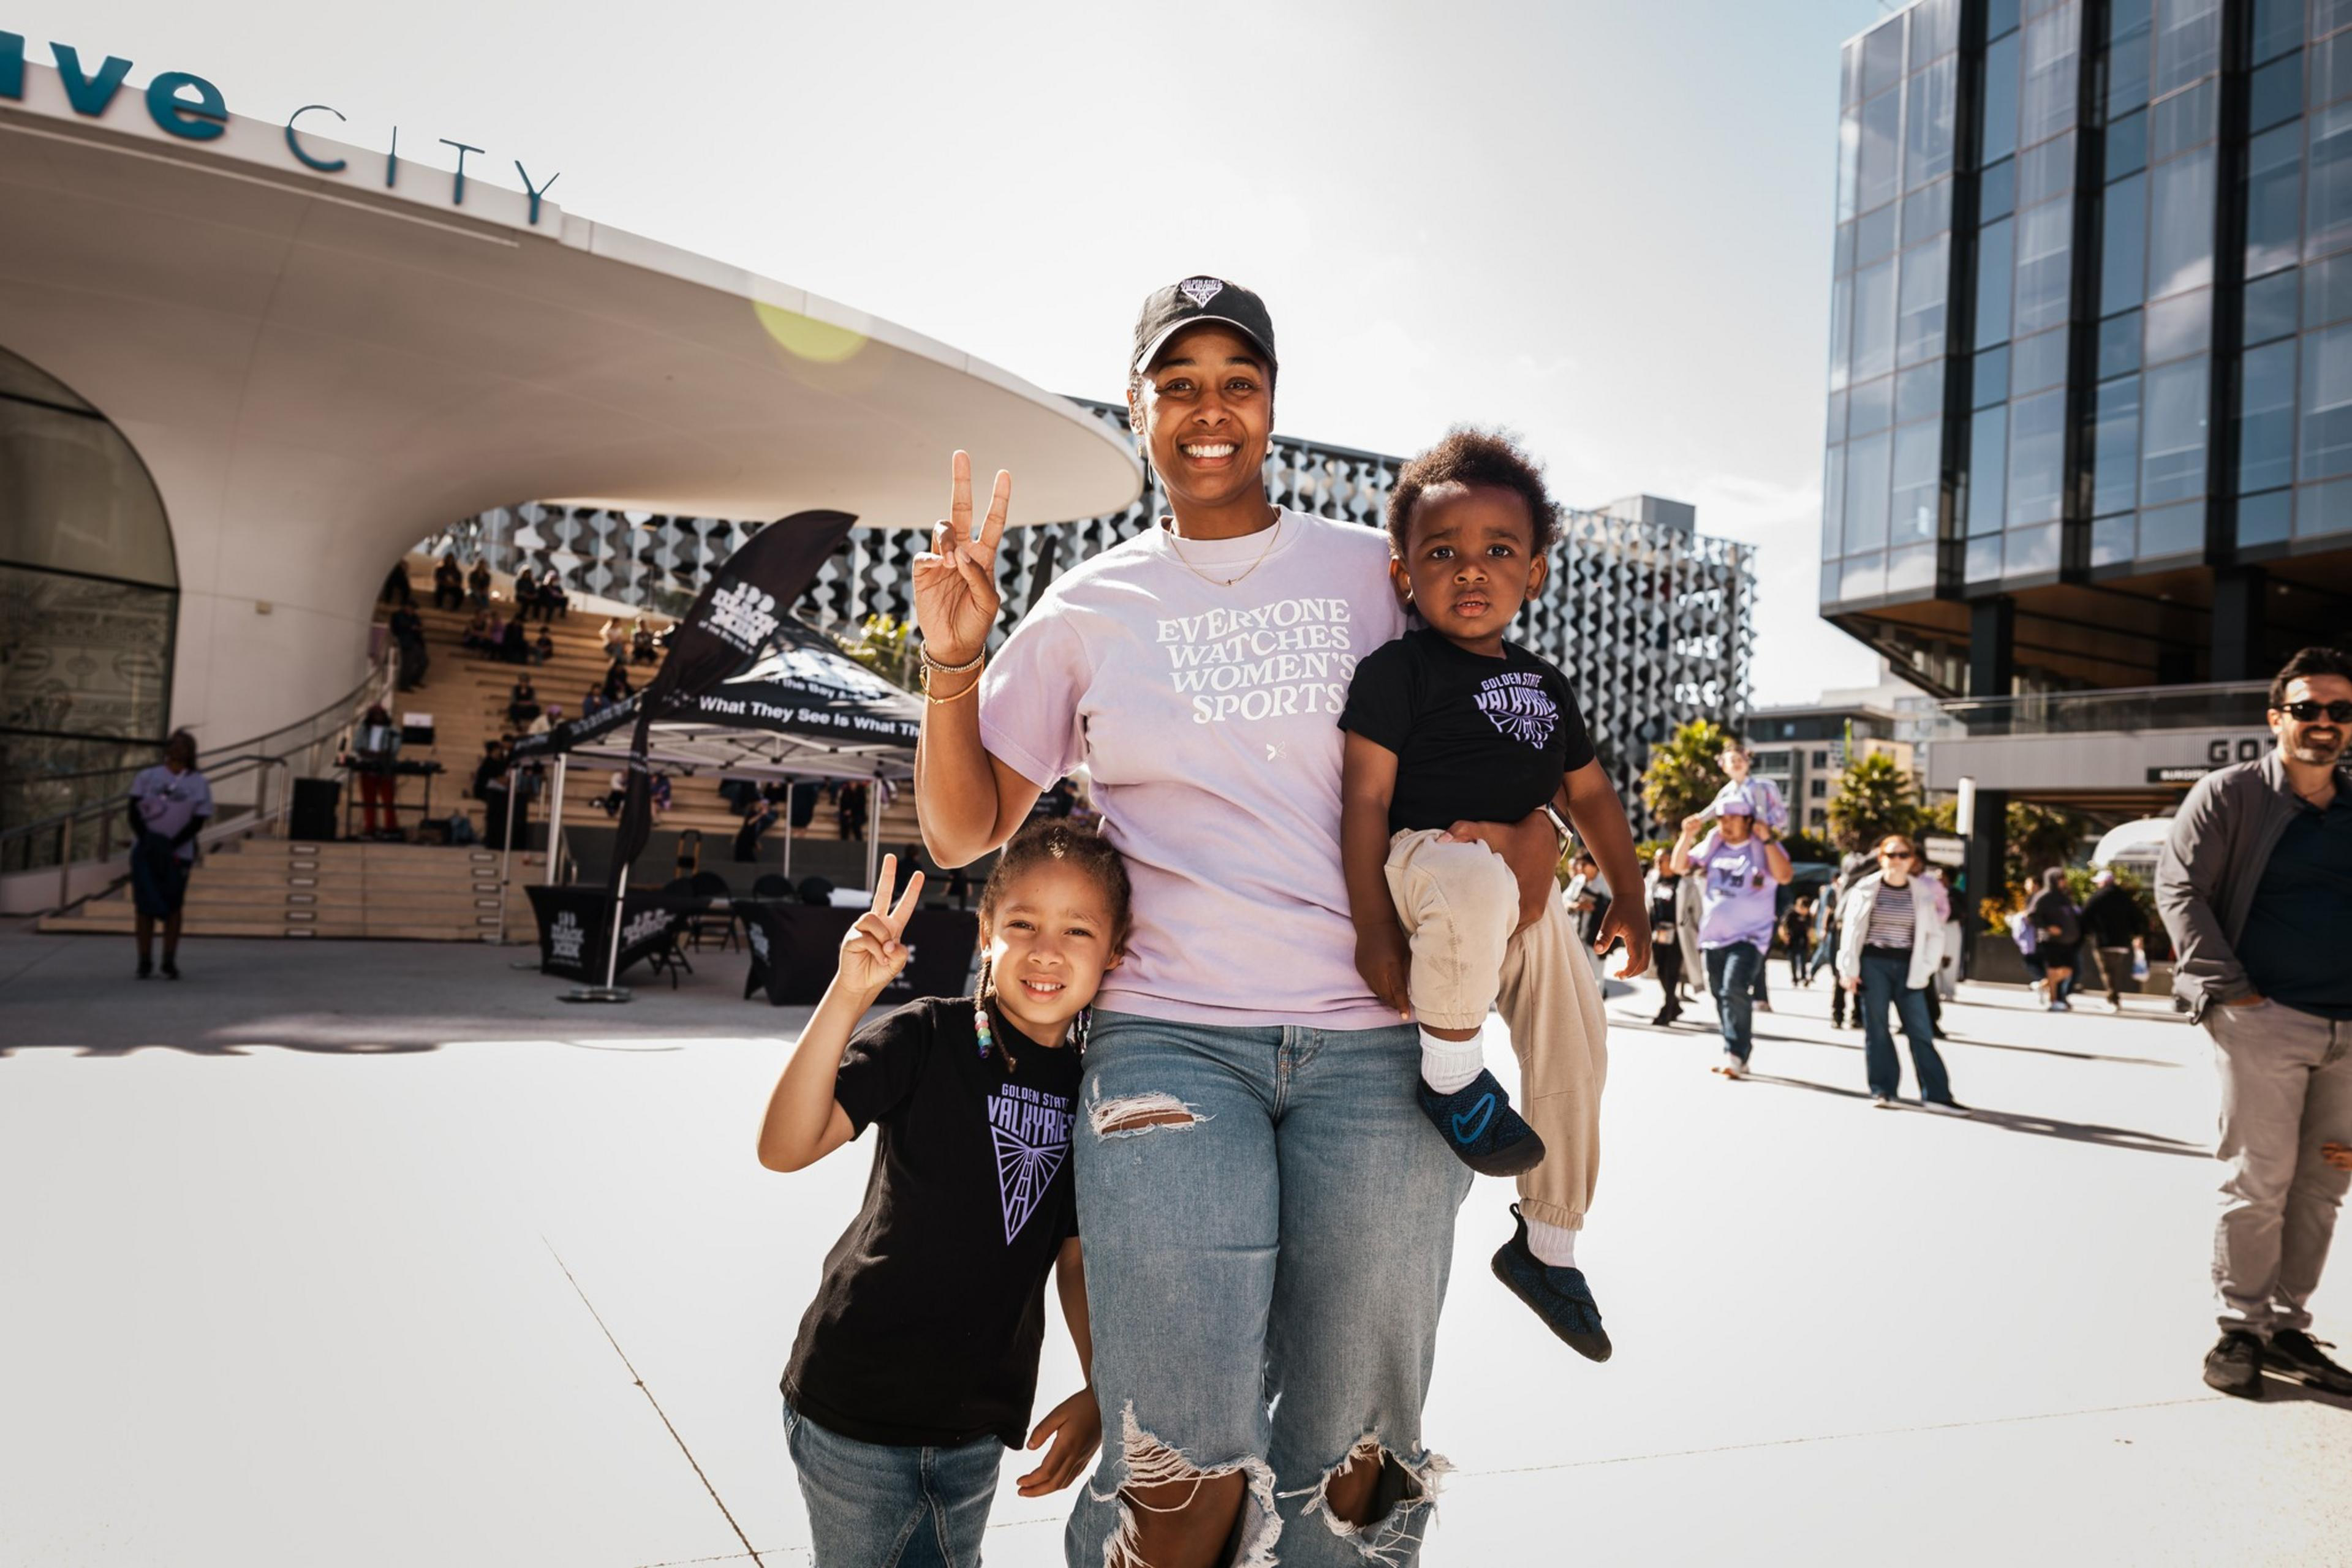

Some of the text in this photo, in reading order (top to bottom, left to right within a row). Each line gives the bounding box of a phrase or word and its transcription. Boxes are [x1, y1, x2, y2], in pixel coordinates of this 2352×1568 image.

[286, 105, 560, 225] CITY
[1156, 598, 1350, 643] EVERYONE
[1166, 625, 1351, 669] WATCHES
[782, 678, 806, 691] the
[807, 683, 835, 699] Bay
[1169, 652, 1356, 693] WOMEN'S
[1481, 673, 1543, 691] GOLDEN STATE
[699, 695, 746, 715] What
[750, 701, 794, 723] They
[798, 708, 830, 724] See
[834, 712, 849, 728] Is
[853, 715, 896, 734] What
[901, 722, 919, 737] Th
[1193, 684, 1346, 724] SPORTS
[1002, 1083, 1039, 1104] GOLDEN
[987, 1095, 1076, 1145] VALKYRIES
